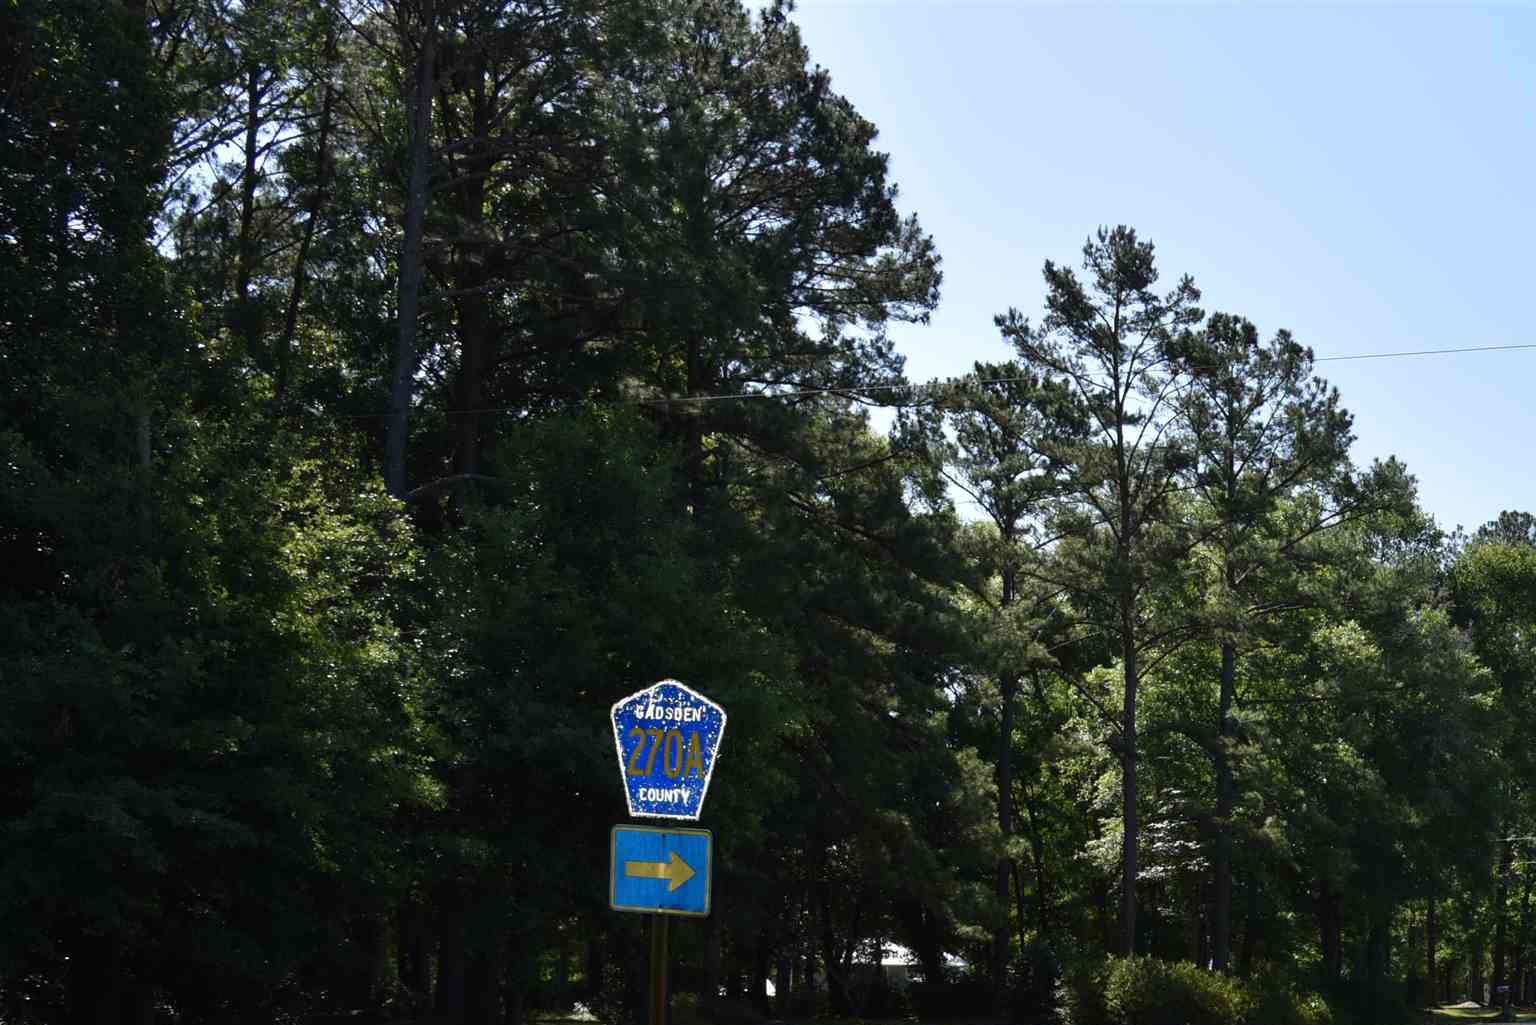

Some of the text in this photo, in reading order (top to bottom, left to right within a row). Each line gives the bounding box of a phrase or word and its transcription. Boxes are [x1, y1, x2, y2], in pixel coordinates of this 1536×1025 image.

[635, 704, 702, 722] GADSDEN
[626, 728, 705, 779] 270A
[640, 787, 690, 806] COUNTY
